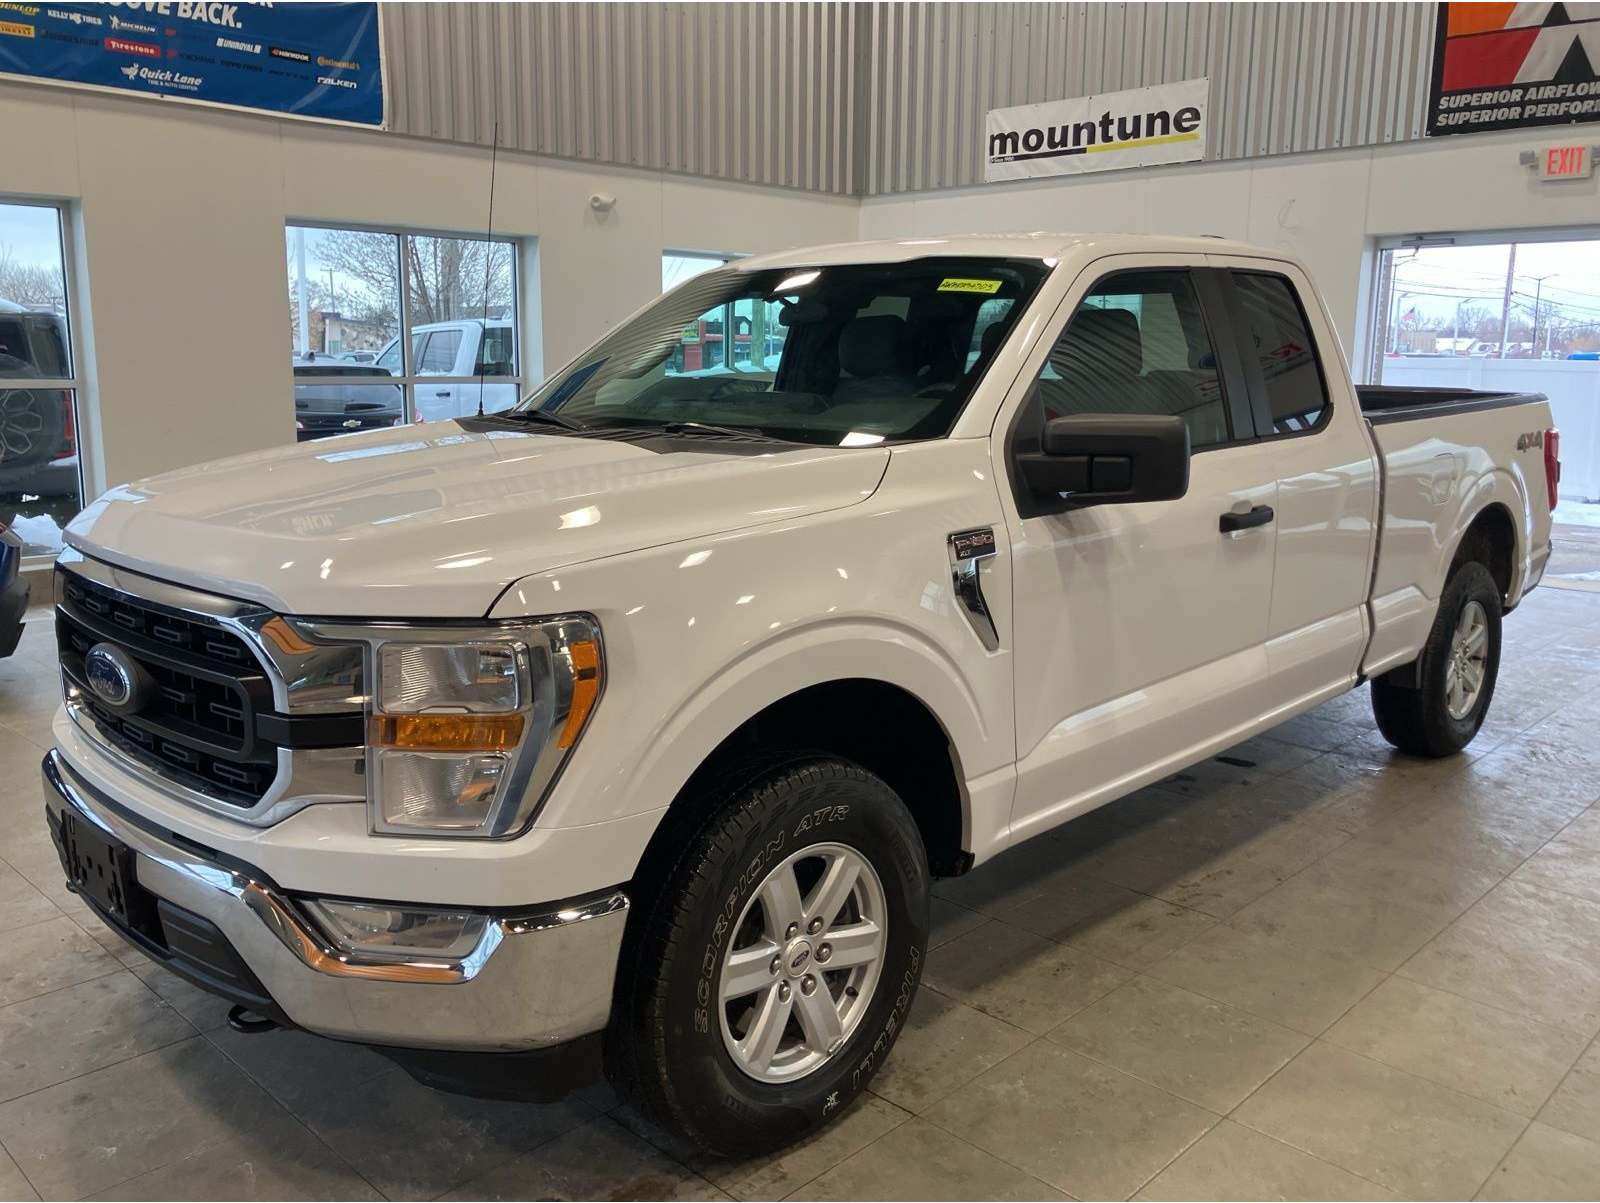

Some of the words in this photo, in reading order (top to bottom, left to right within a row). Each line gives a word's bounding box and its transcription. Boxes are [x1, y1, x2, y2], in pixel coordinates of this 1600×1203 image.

[120, 21, 156, 33] MICHELIN
[110, 40, 155, 55] Firestone
[140, 67, 172, 81] Quick
[174, 72, 203, 86] Lane
[1438, 90, 1522, 109] SUPERIOR
[1436, 106, 1521, 126] SUPERIOR
[989, 106, 1202, 156] mountune
[1547, 146, 1585, 176] EXIT
[695, 830, 785, 1034] SCORPION
[793, 805, 850, 837] ATR
[853, 945, 920, 1091] PIRELLI
